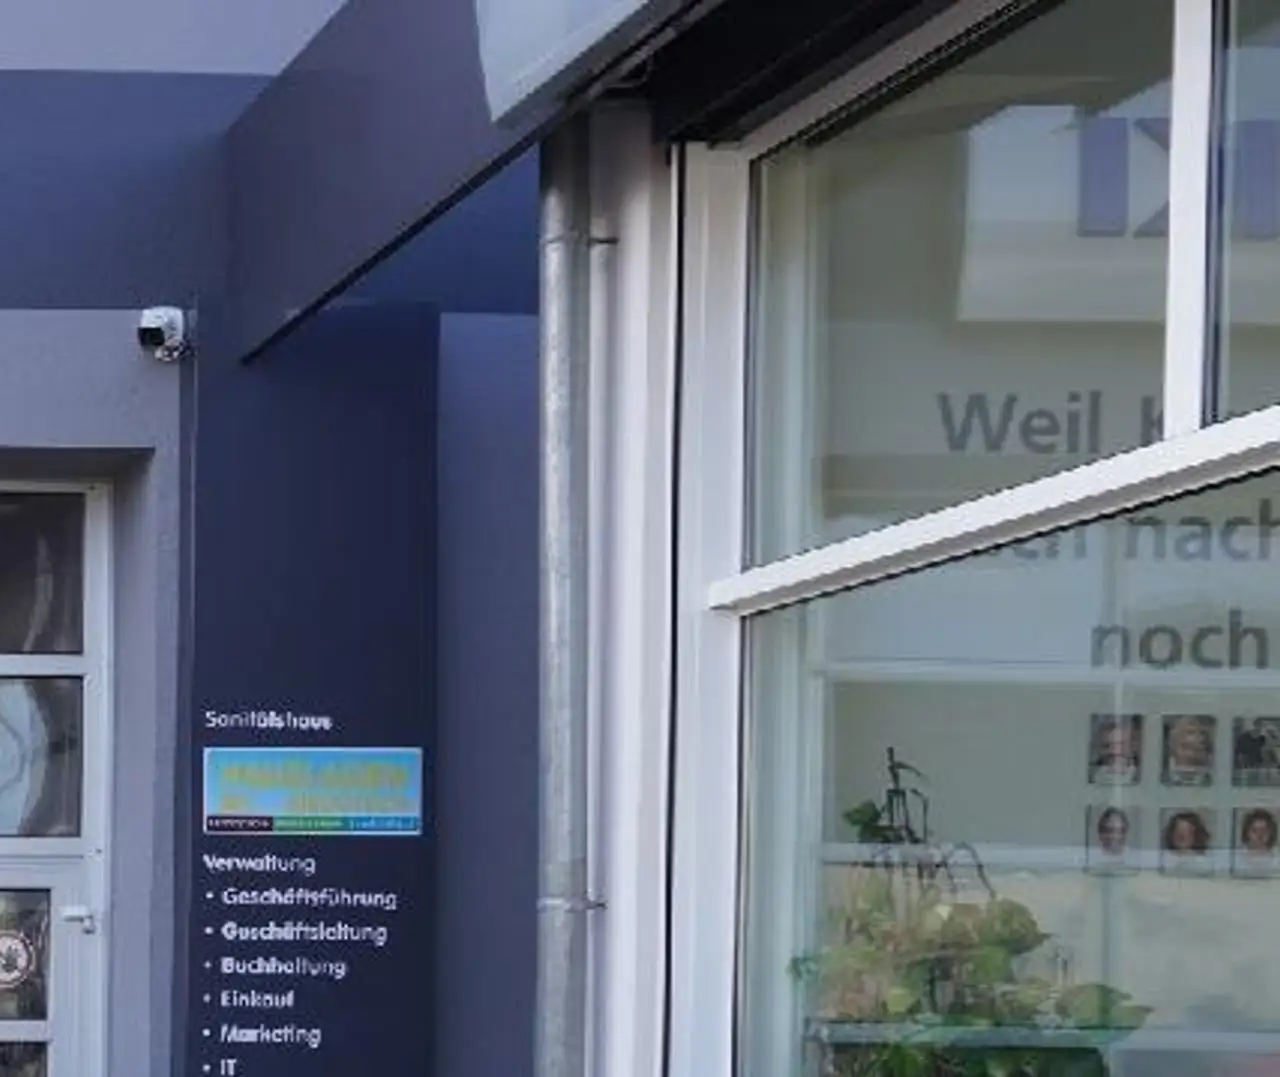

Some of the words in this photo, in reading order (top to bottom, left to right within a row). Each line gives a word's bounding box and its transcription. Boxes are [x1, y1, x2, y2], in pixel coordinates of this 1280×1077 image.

[937, 391, 1102, 454] Weil
[1091, 609, 1269, 669] noch
[205, 711, 333, 730] Sanitätshaus
[203, 854, 316, 877] Verwaltung
[222, 888, 397, 910] Geschäftsführung
[221, 921, 388, 947] Geschäftsleitung
[221, 957, 346, 980] Buchhaltung
[221, 990, 295, 1008] Einkauf
[221, 1024, 322, 1049] Marketing
[220, 1058, 238, 1076] IT
